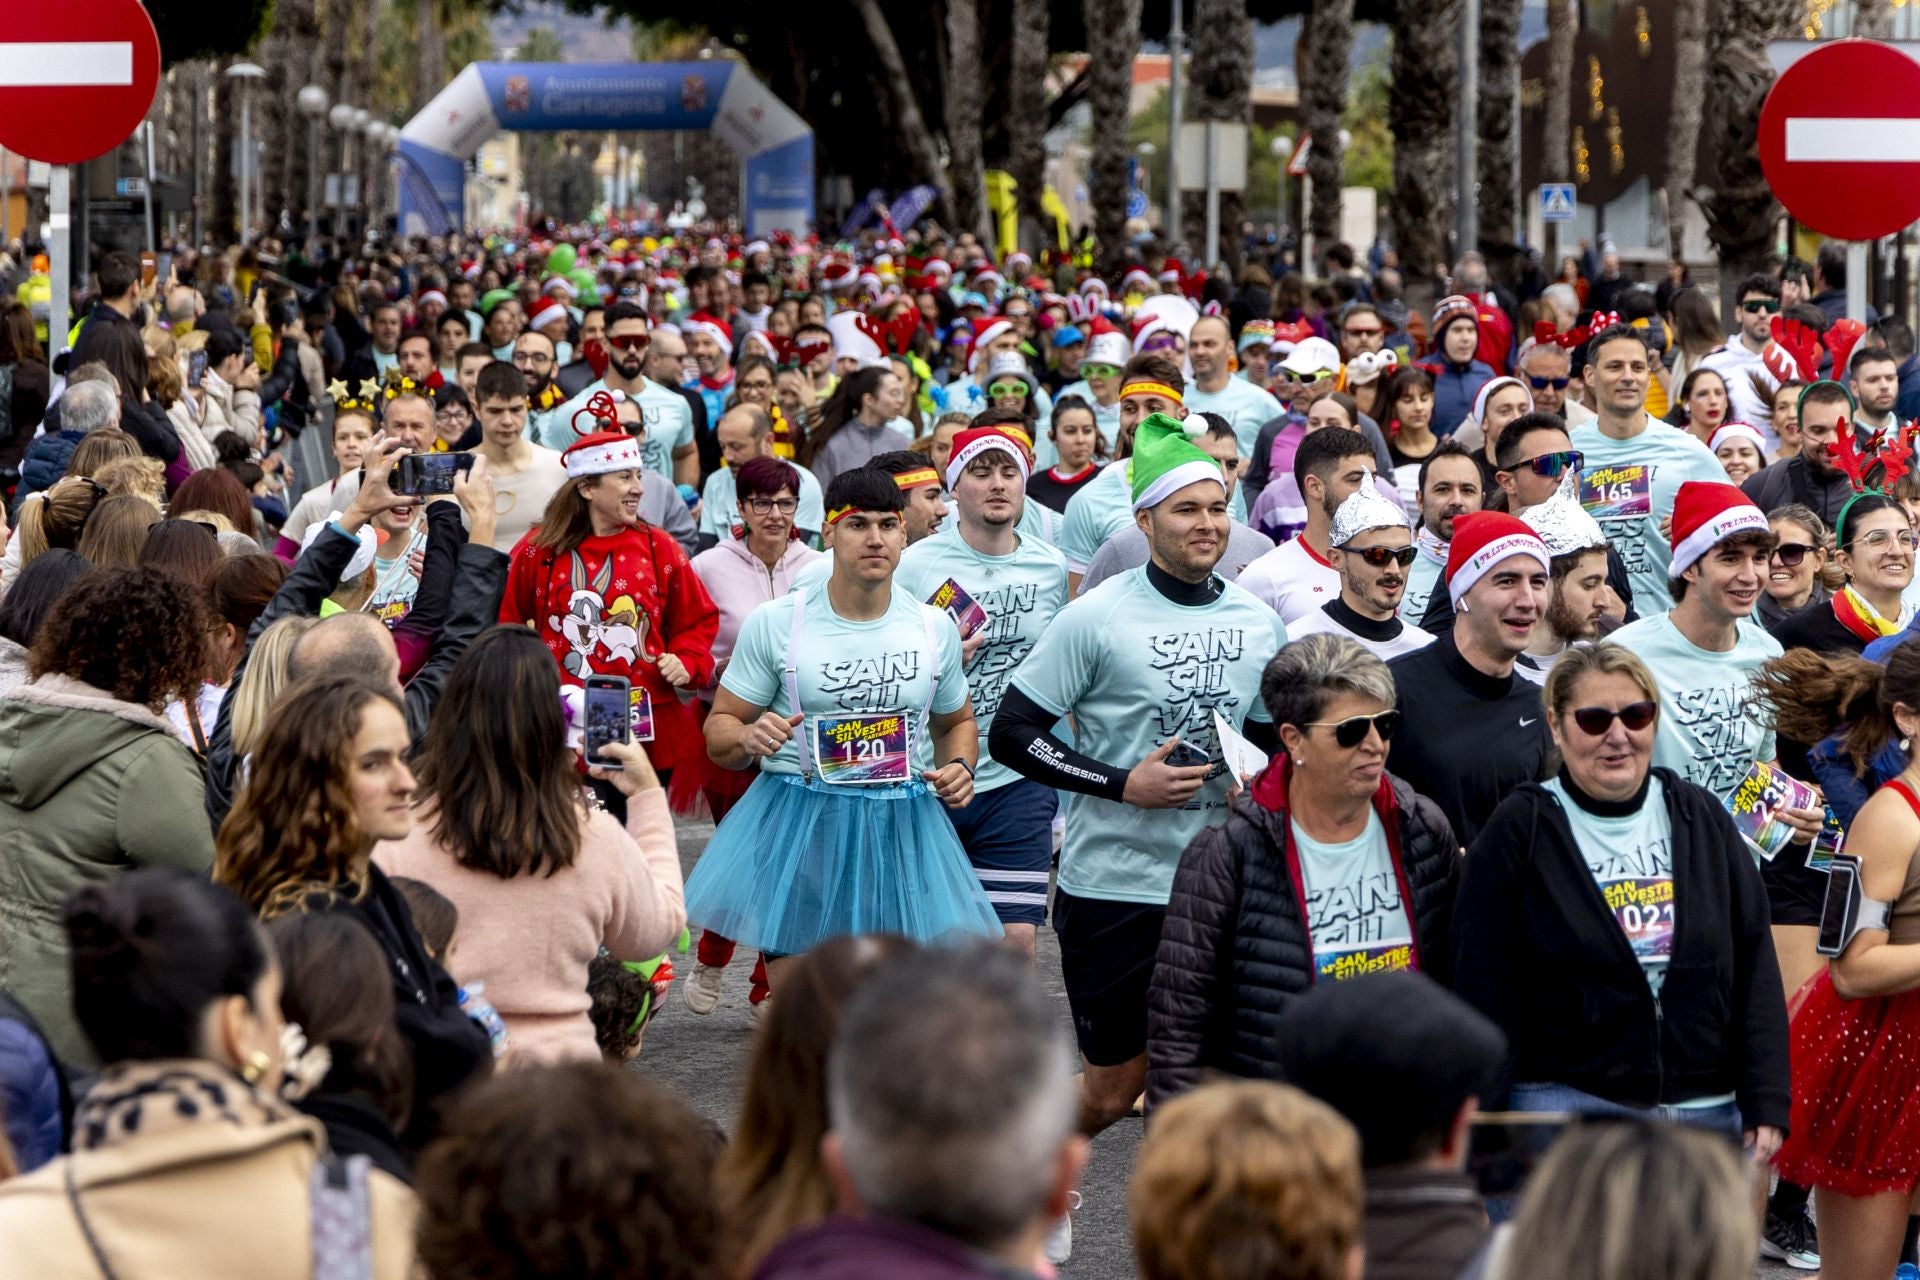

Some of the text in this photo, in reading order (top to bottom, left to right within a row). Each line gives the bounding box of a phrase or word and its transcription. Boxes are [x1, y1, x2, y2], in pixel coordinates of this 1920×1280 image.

[1596, 482, 1632, 502] 165
[1149, 627, 1243, 669] SAN
[818, 651, 919, 693] SAN
[1166, 664, 1231, 704] SIL
[835, 717, 898, 744] SILVESTRE
[836, 721, 861, 734] SAN
[1692, 720, 1752, 762] SIL
[842, 739, 885, 762] 120
[1033, 737, 1065, 759] GOLF
[1027, 744, 1109, 785] COMPRESSION
[1735, 776, 1756, 806] SAN
[1603, 881, 1635, 899] SAN
[1606, 881, 1674, 909] SILVESTR
[1336, 951, 1367, 972] SAN
